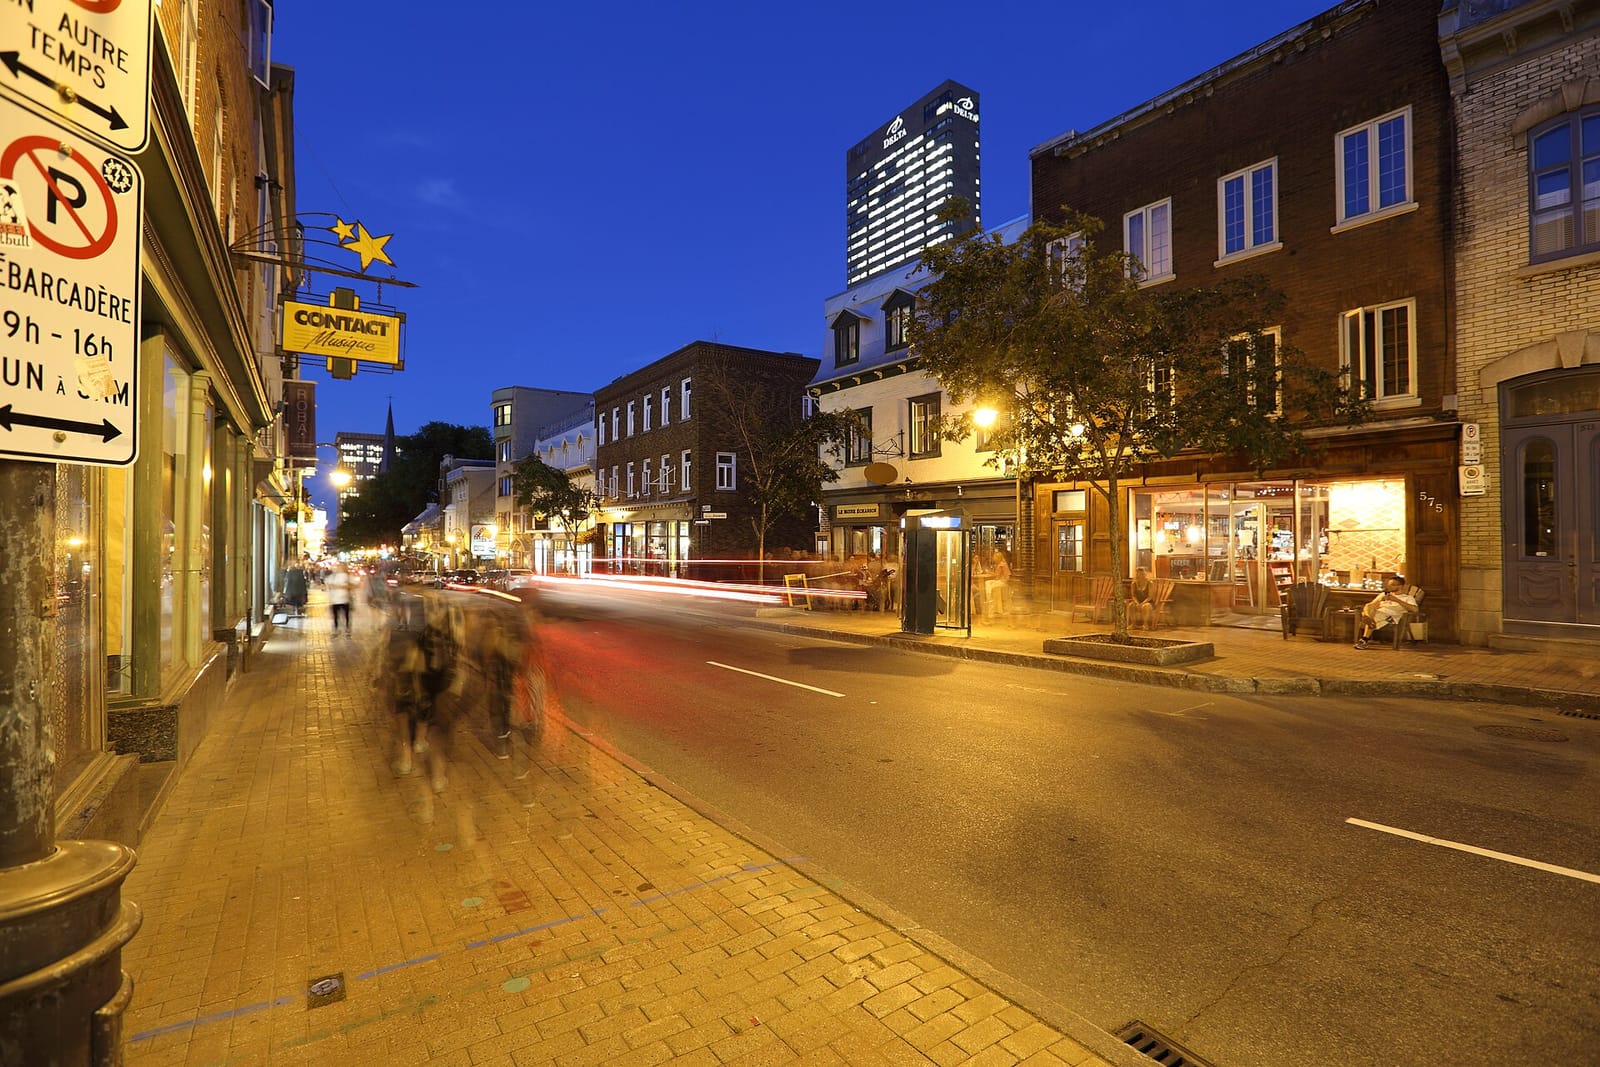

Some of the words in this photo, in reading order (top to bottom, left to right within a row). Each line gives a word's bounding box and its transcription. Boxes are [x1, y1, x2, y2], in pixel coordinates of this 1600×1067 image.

[27, 22, 106, 89] TEMPS
[58, 12, 129, 74] AUTRE
[952, 103, 980, 123] DELTA
[883, 128, 907, 149] DELTA
[294, 309, 390, 337] CONTACT
[3, 310, 40, 345] 9h
[74, 328, 113, 362] 16h
[303, 330, 376, 355] Musique
[56, 375, 66, 396] À
[1419, 491, 1444, 513] 575
